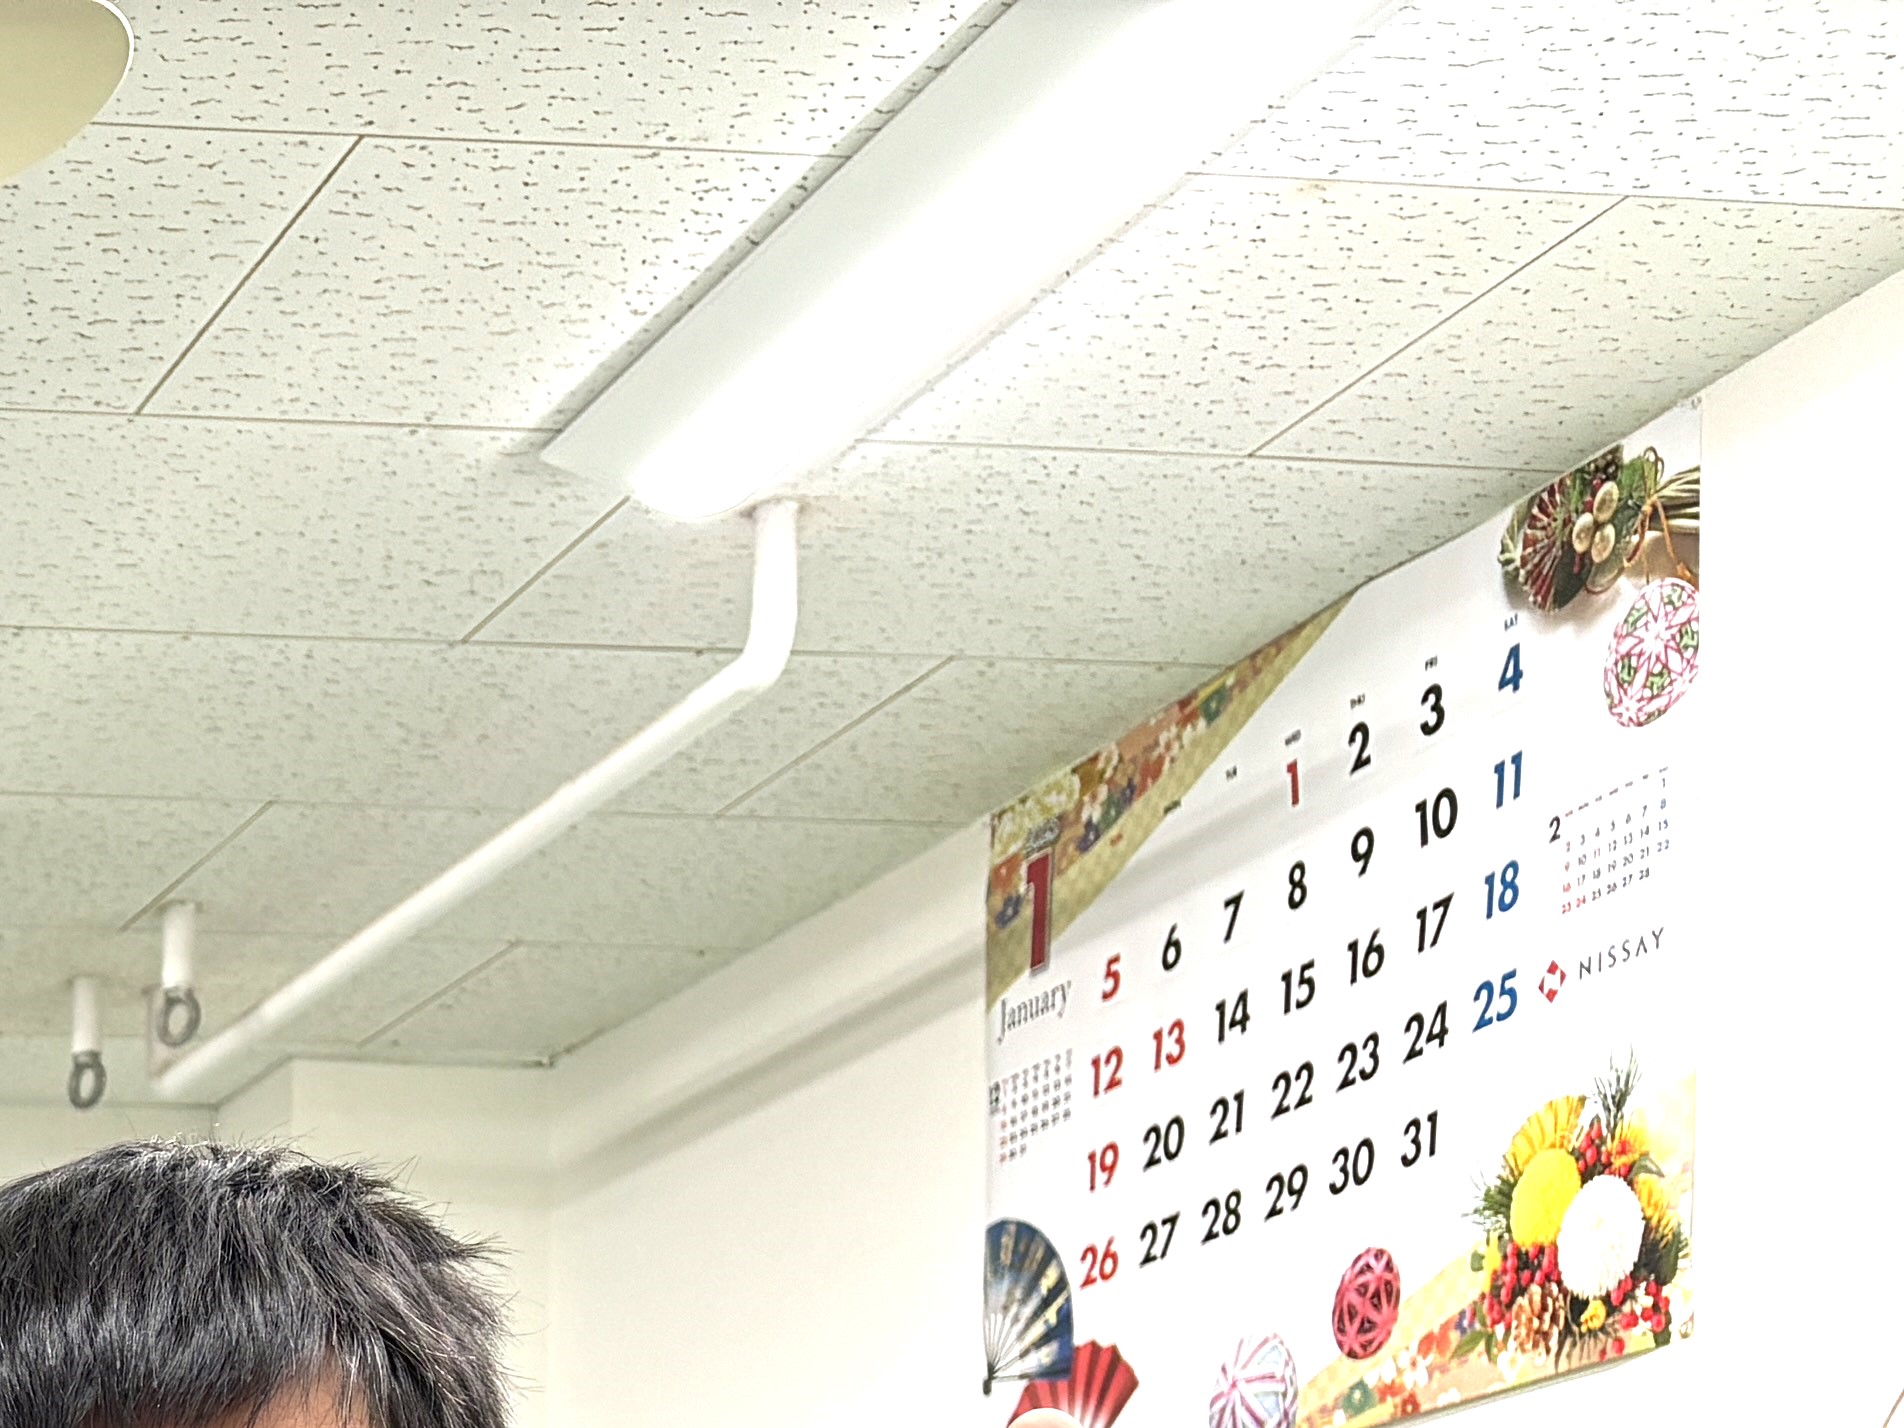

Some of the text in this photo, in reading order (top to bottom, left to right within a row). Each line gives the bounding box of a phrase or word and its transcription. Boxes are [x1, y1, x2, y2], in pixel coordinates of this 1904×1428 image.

[1287, 643, 1523, 807] 1 2 3 4
[1102, 751, 1522, 1002] 5 6 7 8 9 10 11
[1549, 816, 1561, 844] 2
[997, 980, 1072, 1044] January
[1091, 860, 1519, 1097] 12 13 14 15 16 17 18
[1579, 927, 1664, 980] NISSAY
[1088, 969, 1517, 1192] 19 20 21 22 23 24 25
[1080, 1110, 1438, 1289] 26 27 28 29 30 31
